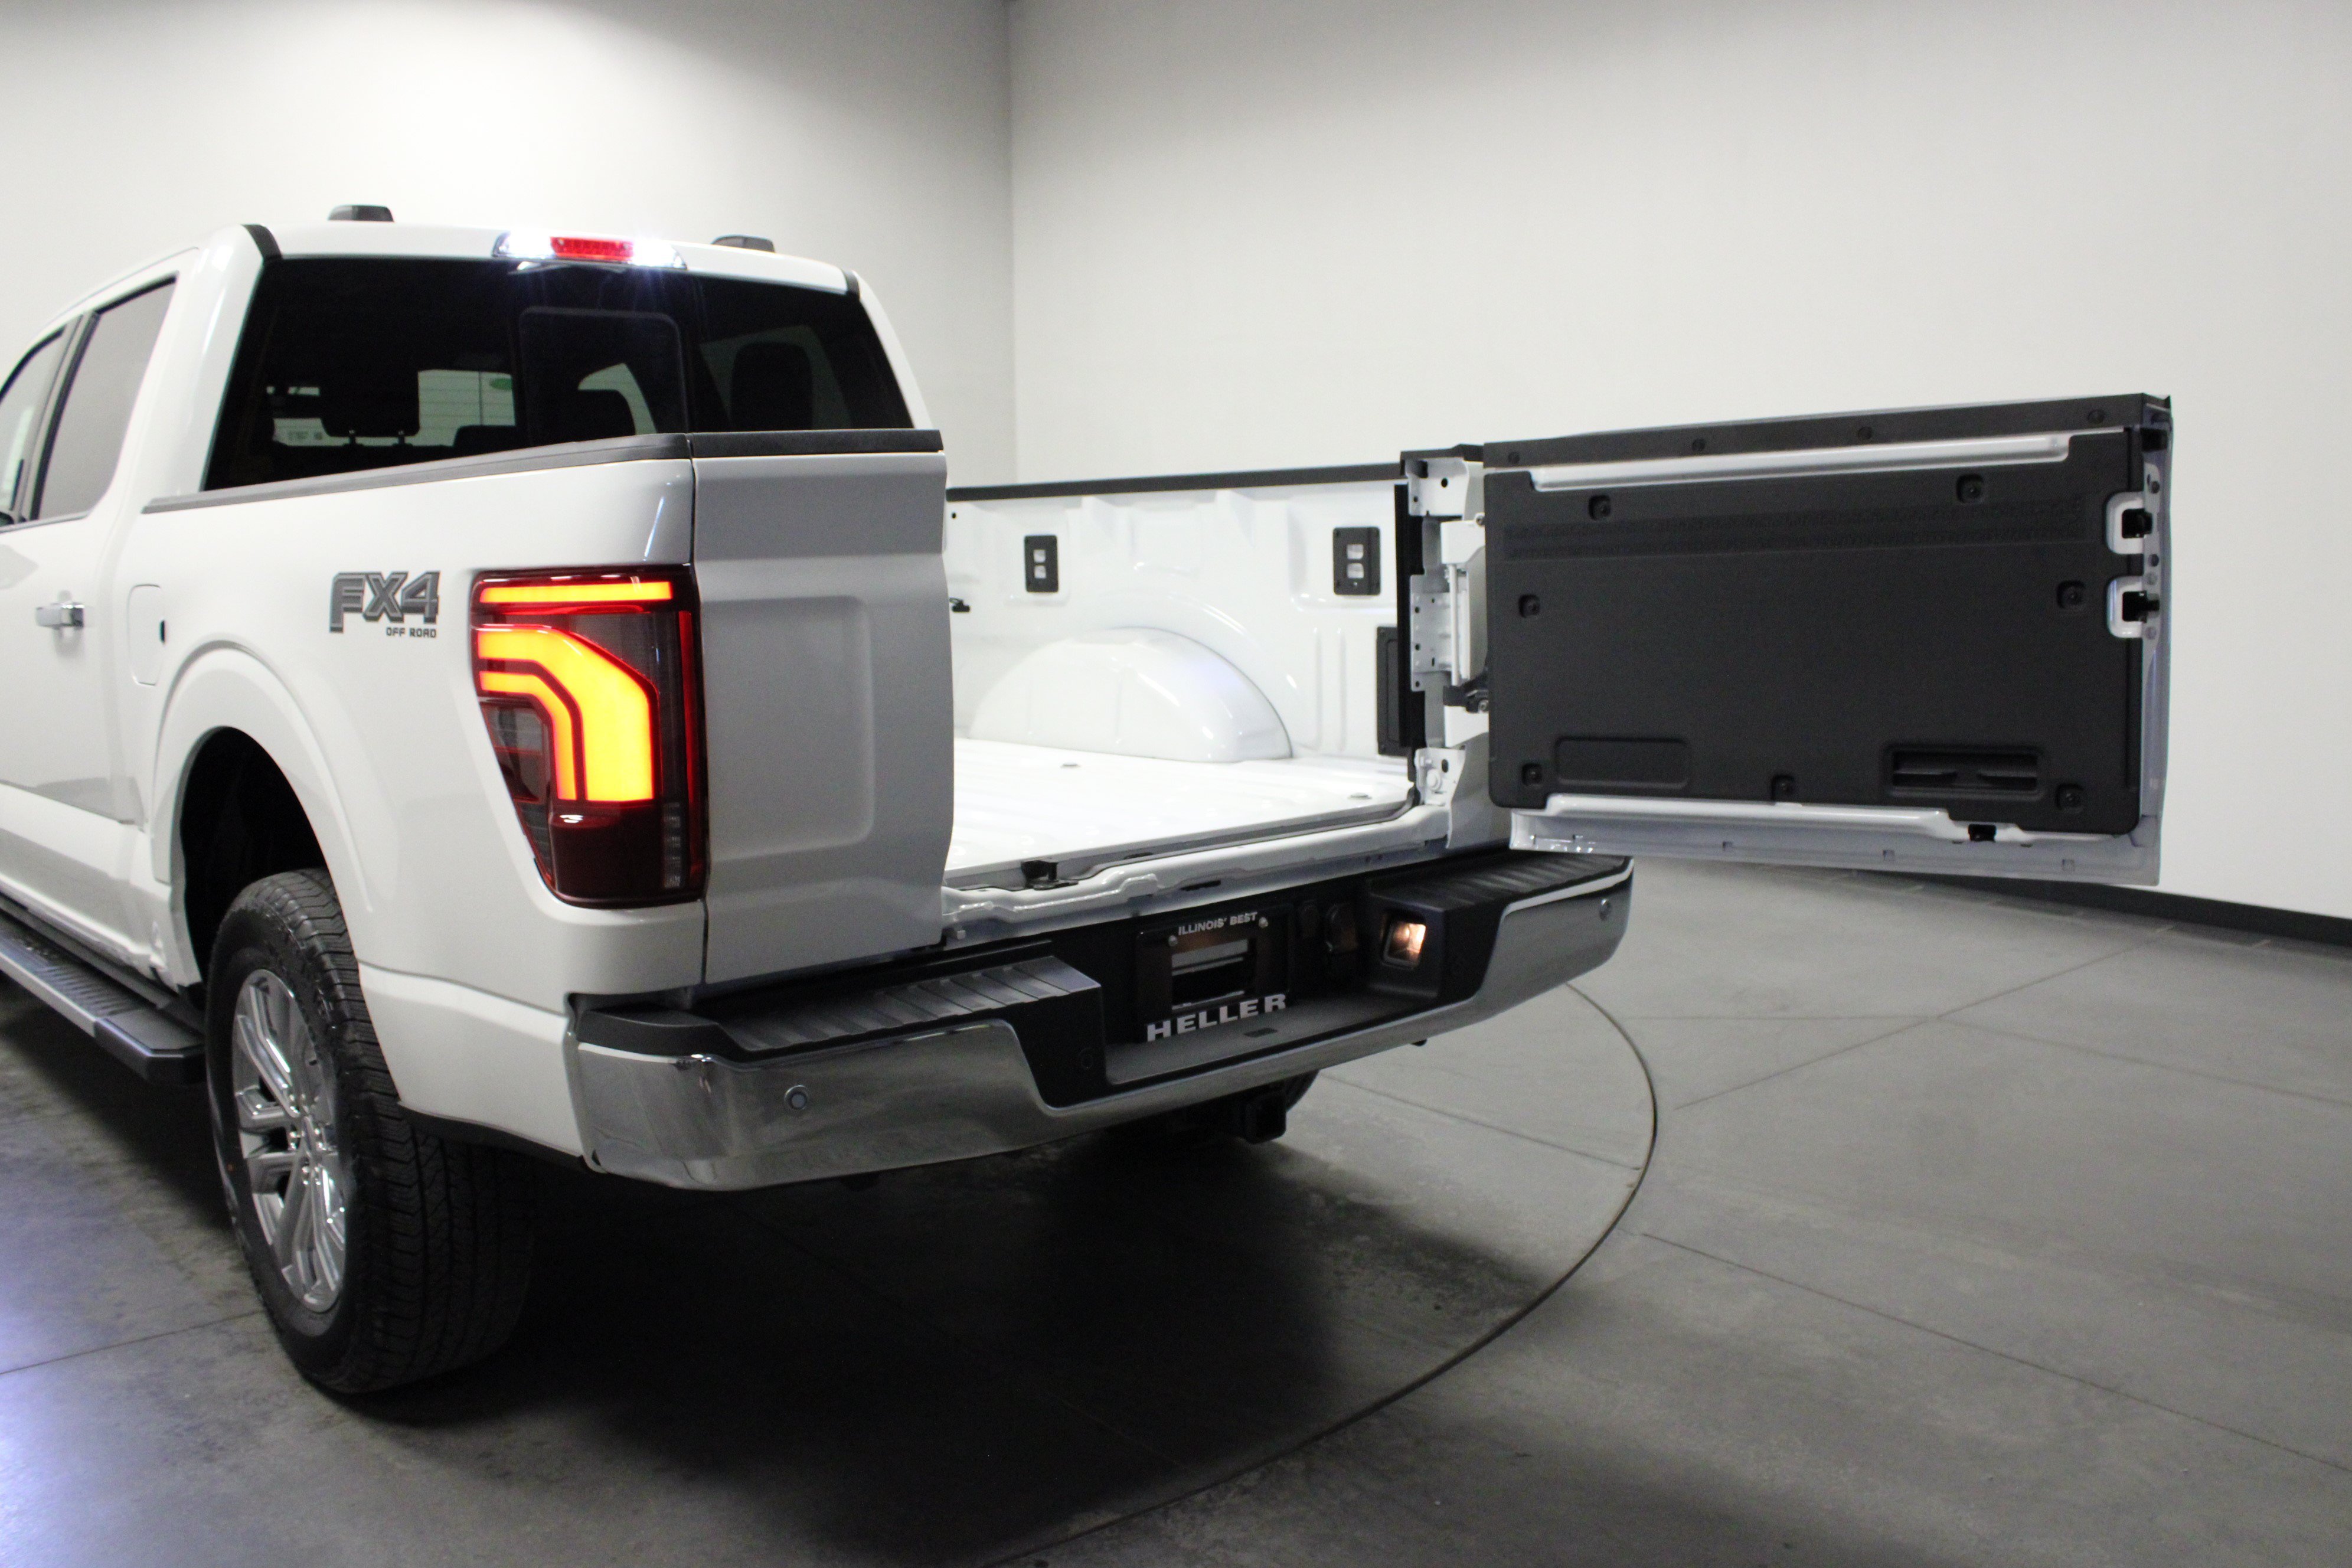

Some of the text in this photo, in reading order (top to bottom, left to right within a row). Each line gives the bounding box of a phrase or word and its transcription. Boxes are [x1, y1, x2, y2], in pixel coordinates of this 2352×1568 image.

[329, 571, 440, 633] FX4
[386, 627, 436, 638] OFF ROAD
[1229, 912, 1258, 926] BEST
[1146, 994, 1286, 1042] HELLER
